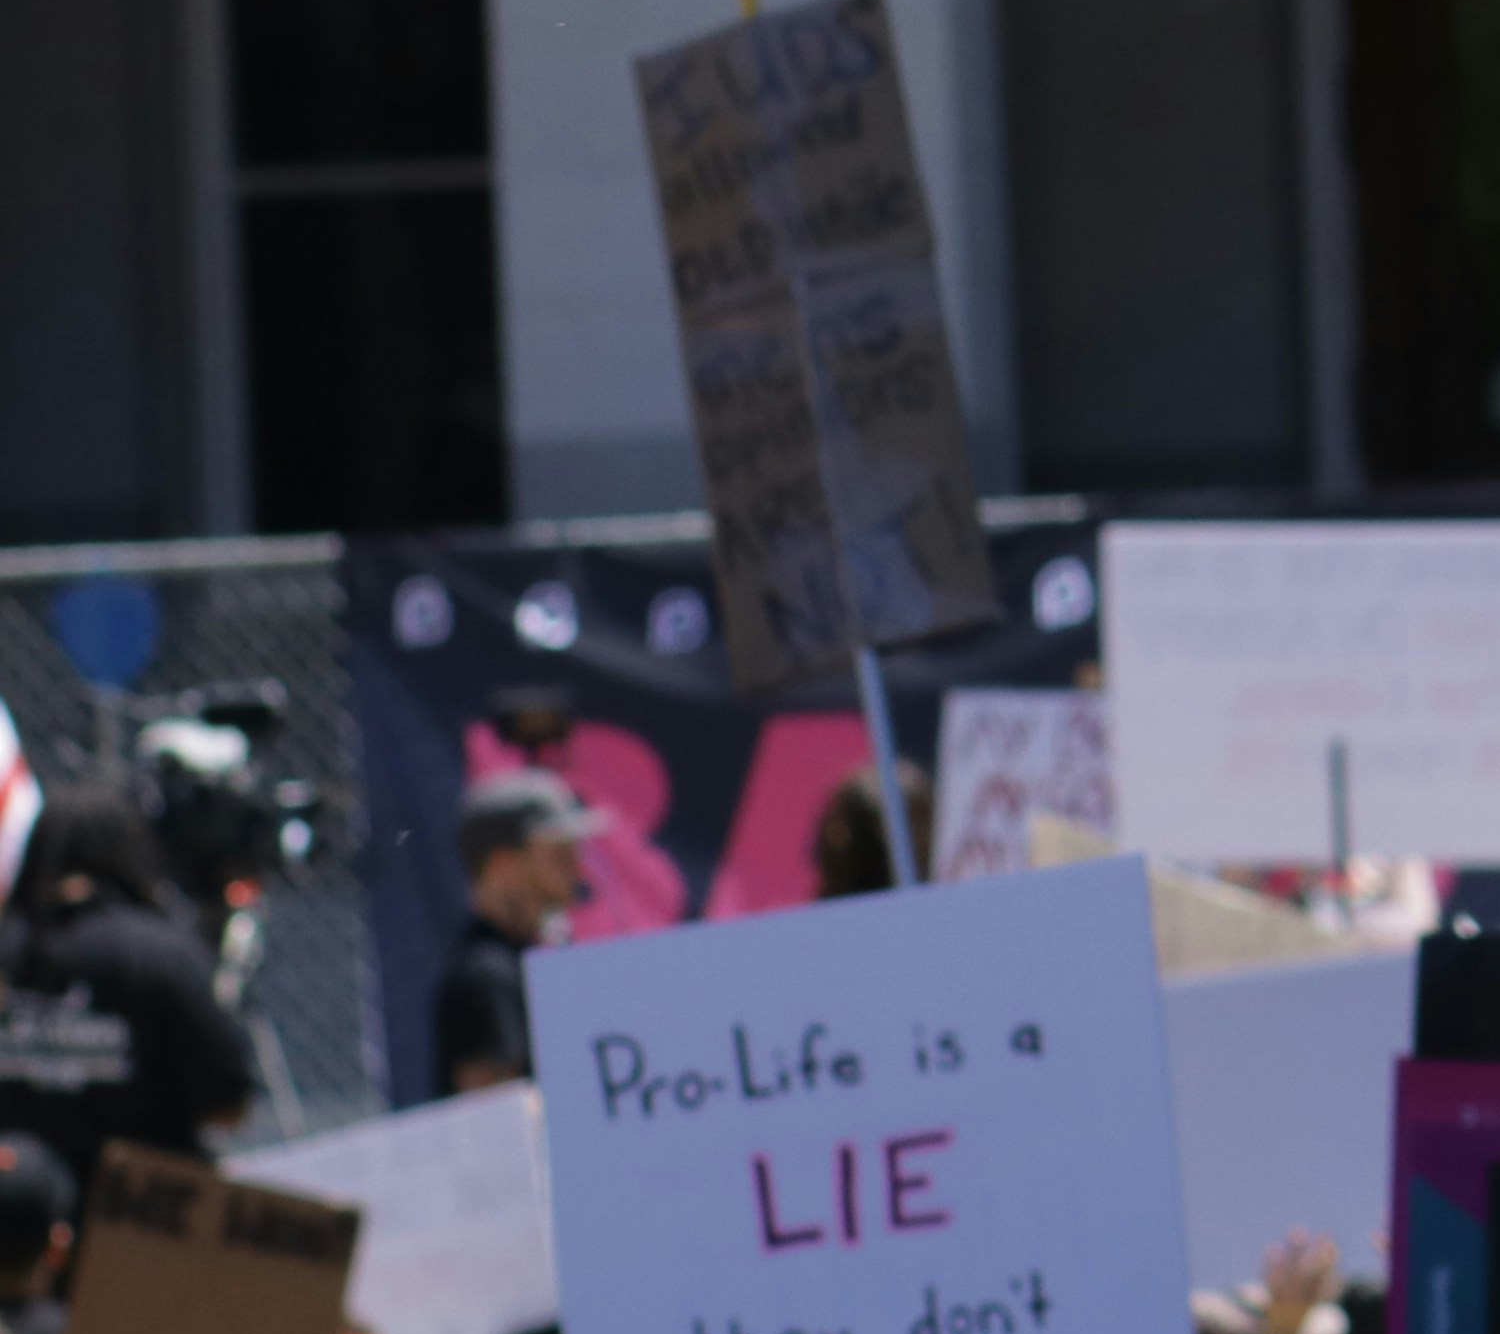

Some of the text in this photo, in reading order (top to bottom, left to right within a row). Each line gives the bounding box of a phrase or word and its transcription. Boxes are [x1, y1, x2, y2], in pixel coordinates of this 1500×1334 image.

[592, 1020, 1043, 1121] Pro-Life is a
[751, 1128, 955, 1254] LIE
